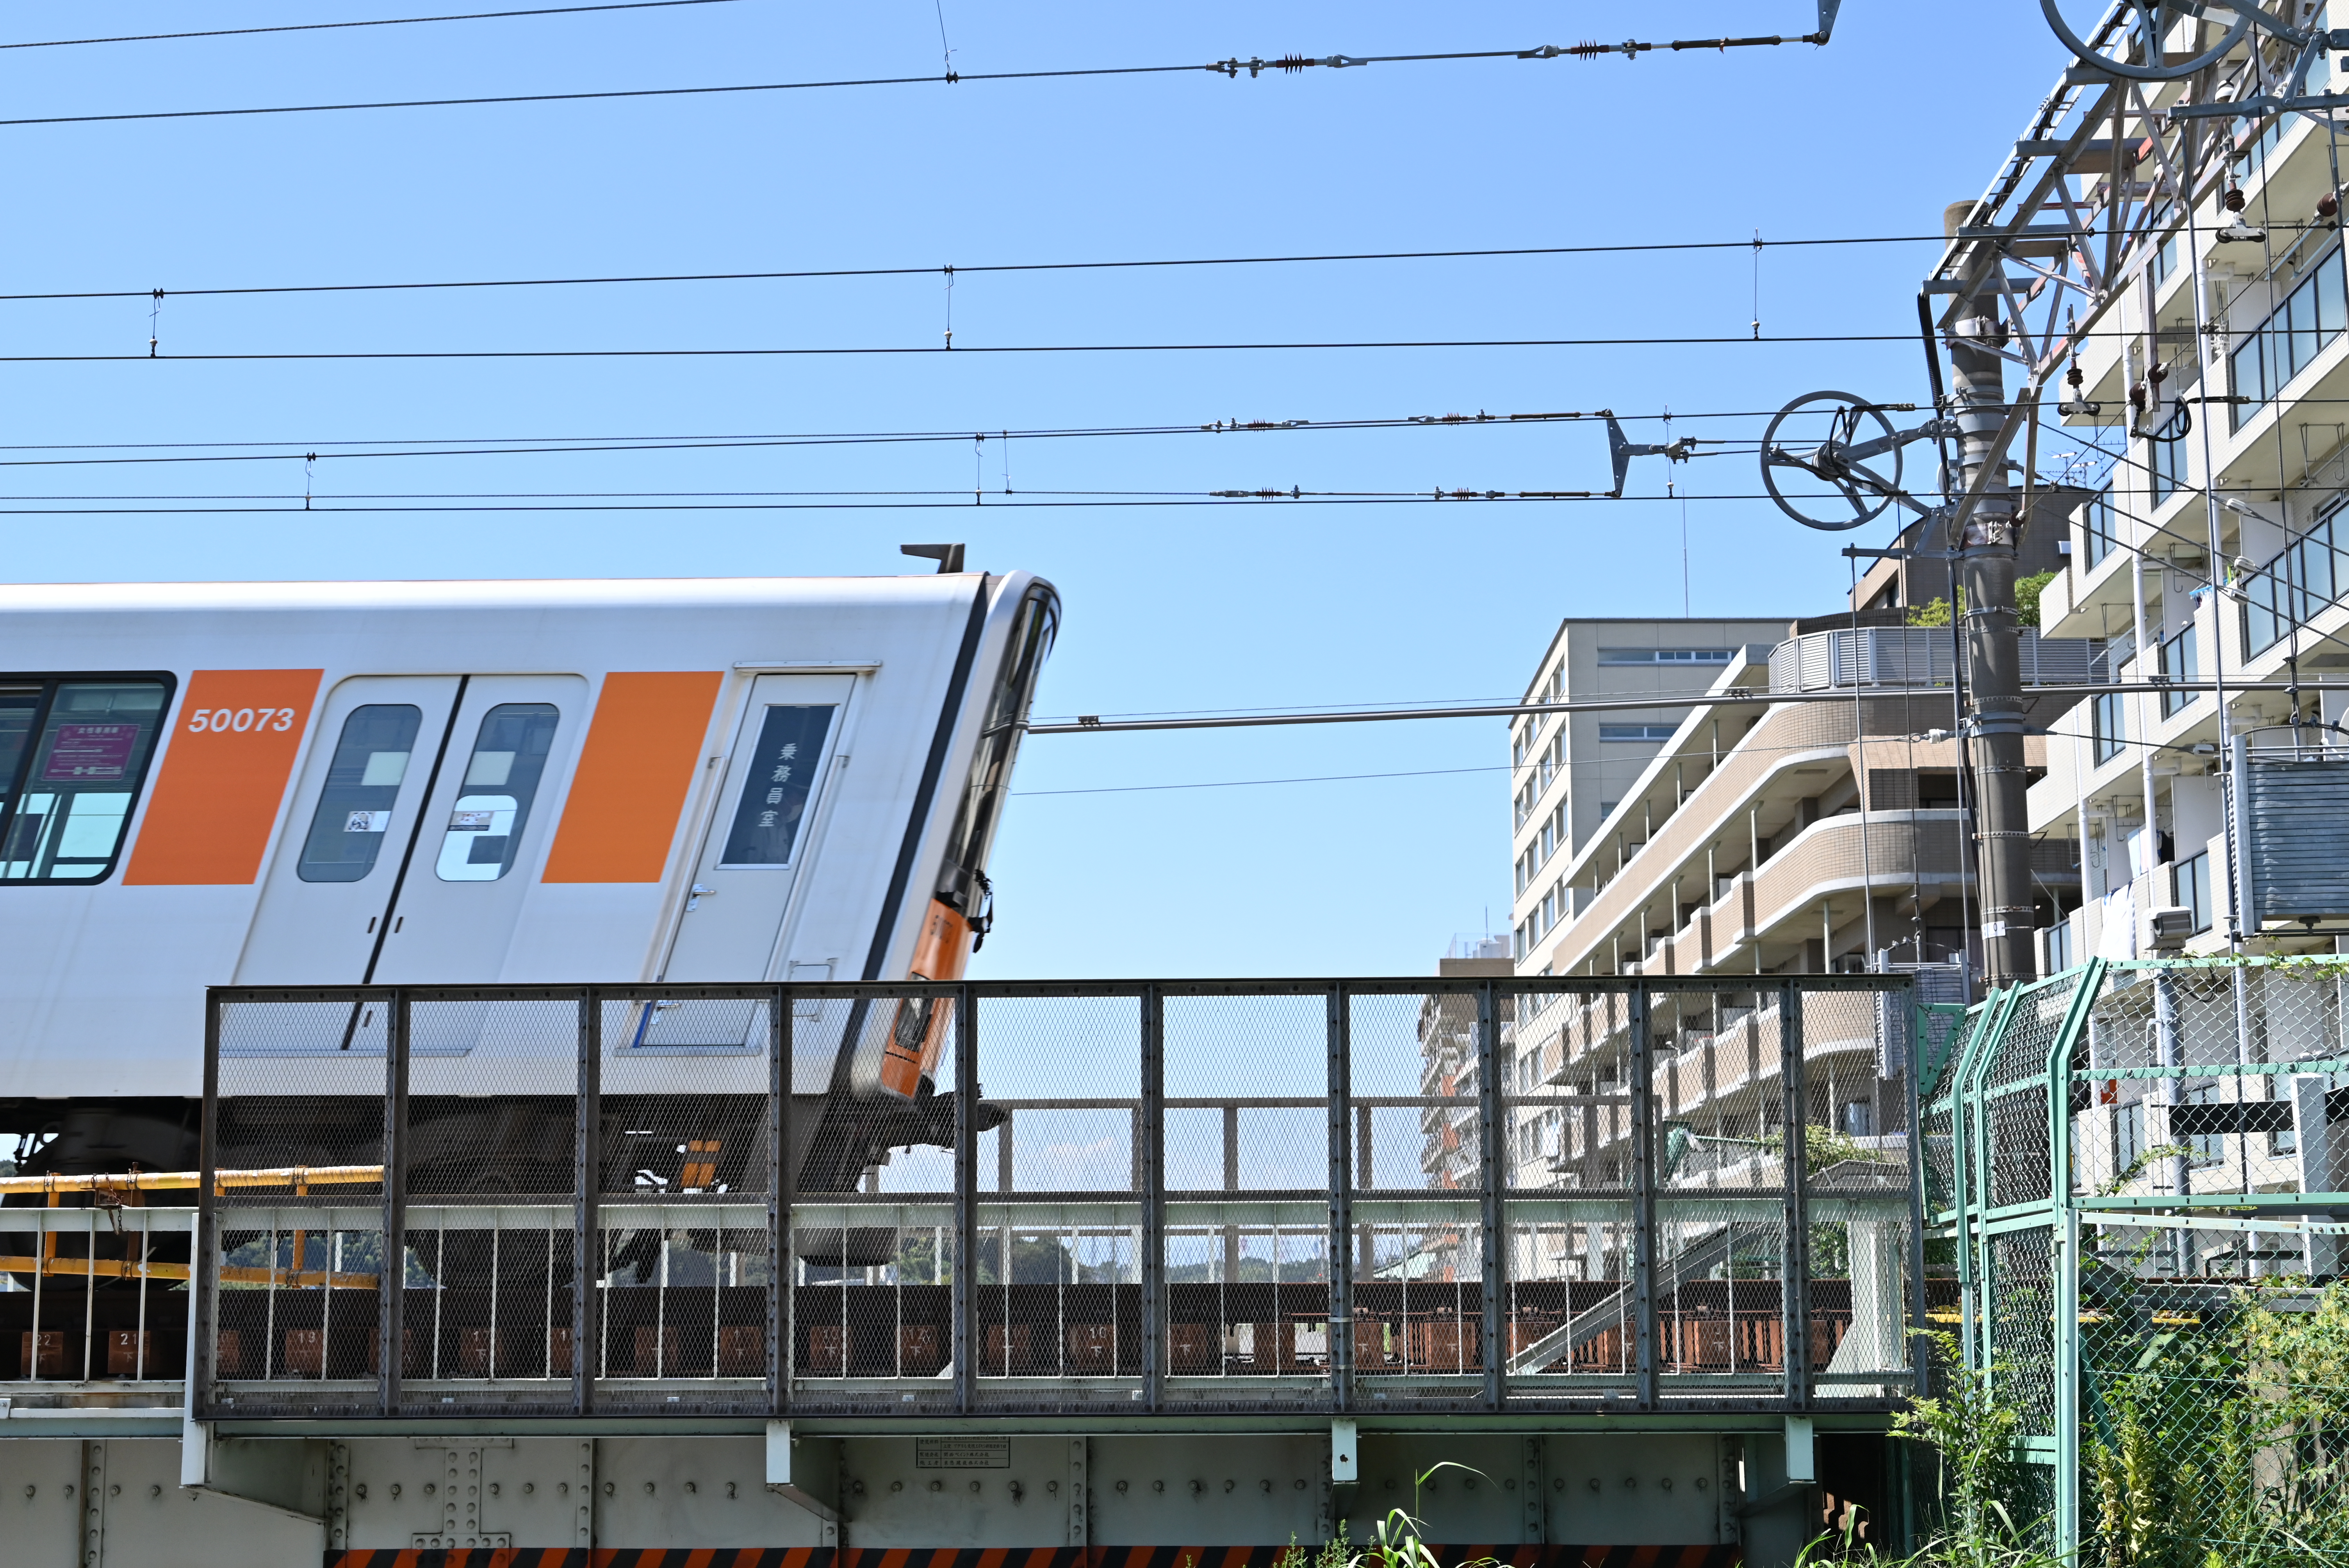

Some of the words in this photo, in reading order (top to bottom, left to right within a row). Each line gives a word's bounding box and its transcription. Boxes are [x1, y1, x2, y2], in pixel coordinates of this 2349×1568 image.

[188, 707, 295, 732] 50073
[757, 743, 797, 827] 乗務員室
[1090, 1326, 1107, 1338] 10
[37, 1334, 51, 1346] 22
[120, 1333, 137, 1345] 21
[1091, 1345, 1102, 1357] 下
[123, 1352, 134, 1363] 下
